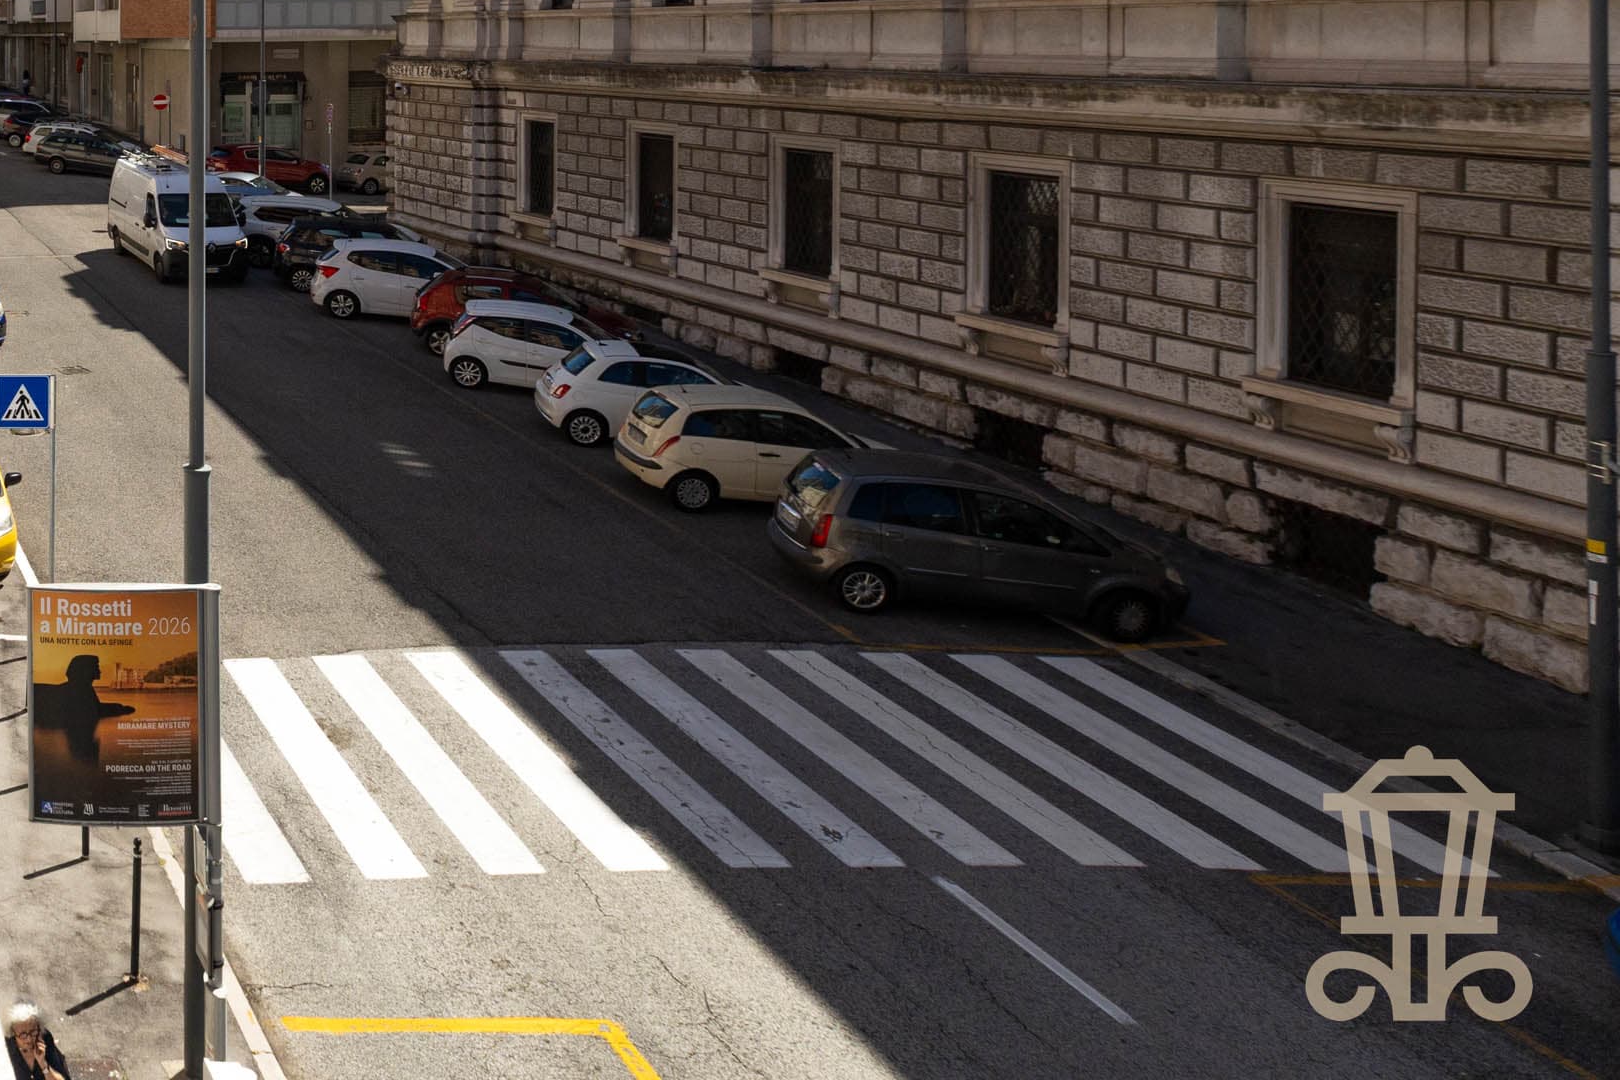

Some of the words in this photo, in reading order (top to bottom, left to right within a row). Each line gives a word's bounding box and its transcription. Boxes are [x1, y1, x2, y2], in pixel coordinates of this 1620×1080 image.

[40, 597, 51, 616] Il
[57, 598, 132, 617] Rossetti
[40, 620, 51, 633] a
[57, 617, 143, 636] Miramare
[148, 616, 191, 636] 2026
[81, 638, 97, 646] CON
[117, 722, 157, 730] MIRAMARE
[157, 721, 191, 729] MYSTERY
[105, 764, 144, 773] PODRECCA
[145, 764, 156, 772] ON
[157, 764, 171, 772] THE
[172, 763, 192, 771] ROAD
